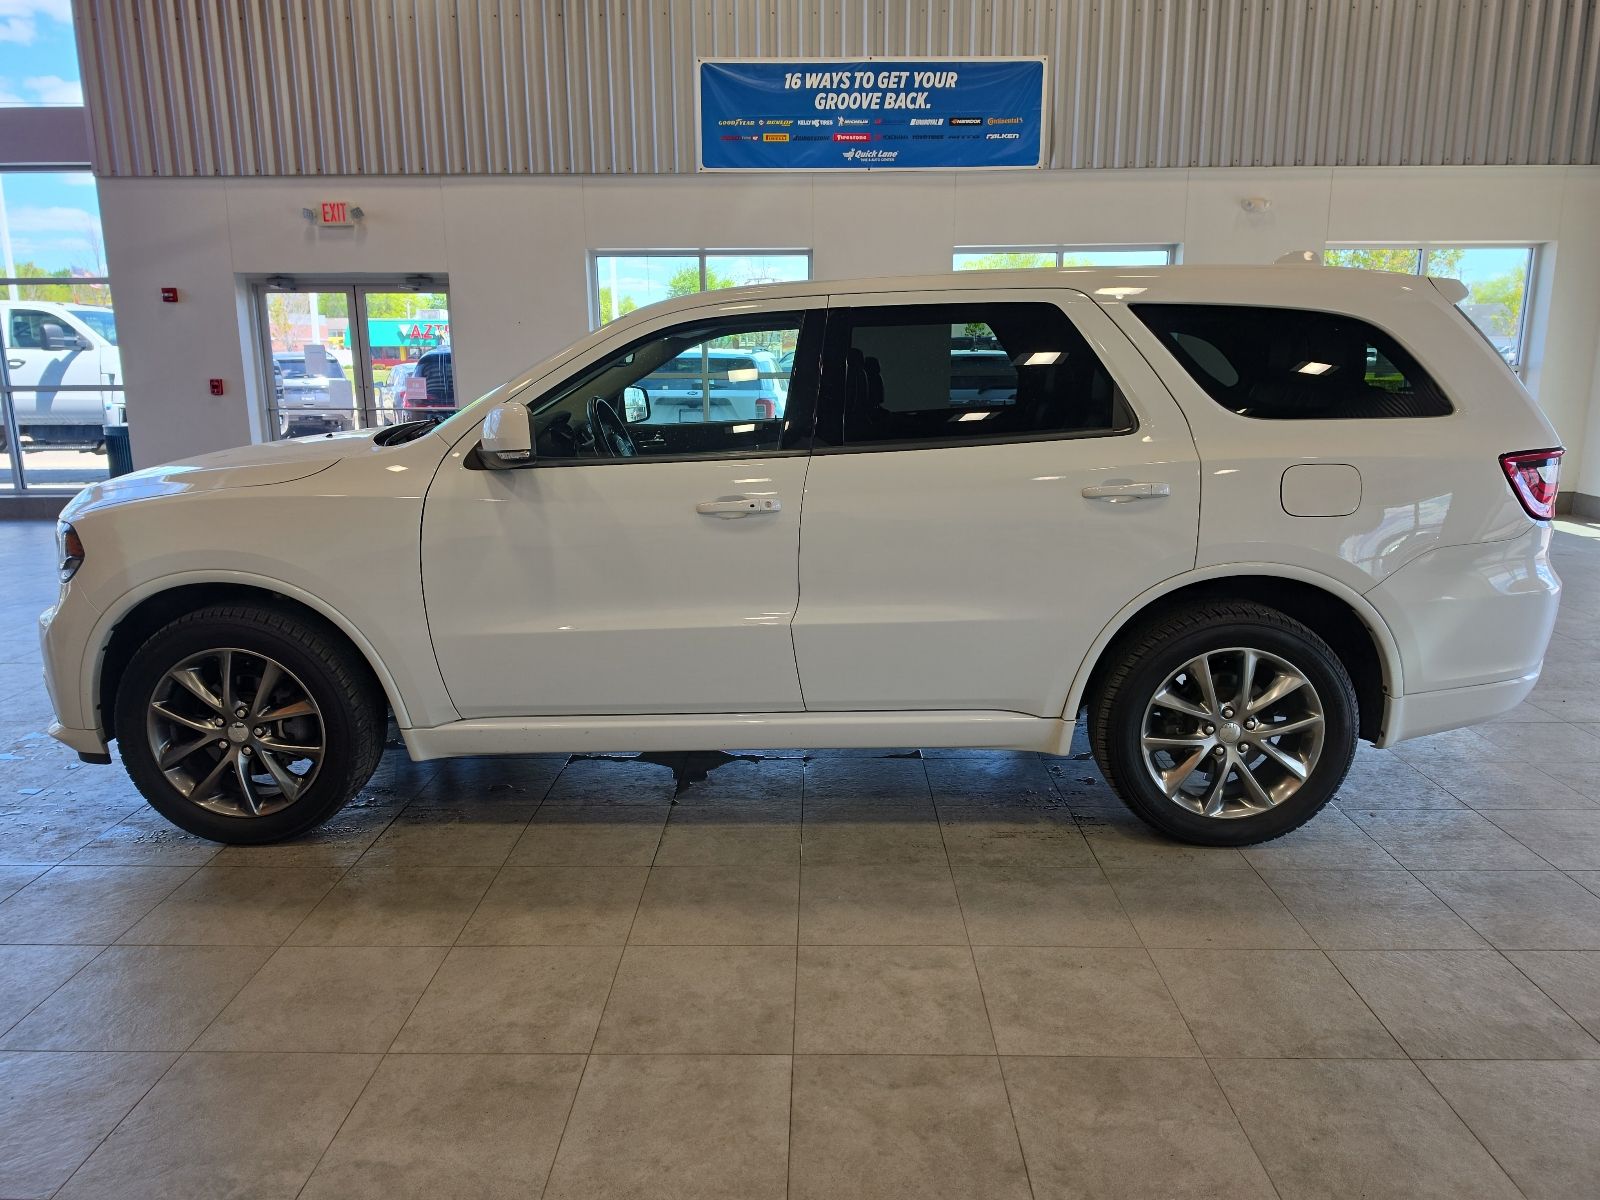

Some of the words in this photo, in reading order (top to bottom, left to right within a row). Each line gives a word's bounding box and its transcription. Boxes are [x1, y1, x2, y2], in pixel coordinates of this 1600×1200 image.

[785, 73, 801, 89] 16
[806, 72, 850, 89] WAYS
[854, 72, 874, 89] TO
[878, 72, 909, 88] GET
[914, 72, 958, 88] YOUR
[815, 92, 881, 110] GROOVE
[884, 92, 931, 109] BACK.
[719, 118, 755, 126] GOODYEAR
[988, 117, 1020, 126] Continental
[855, 149, 877, 158] Quick
[878, 149, 898, 158] Lane
[322, 202, 346, 223] EXIT
